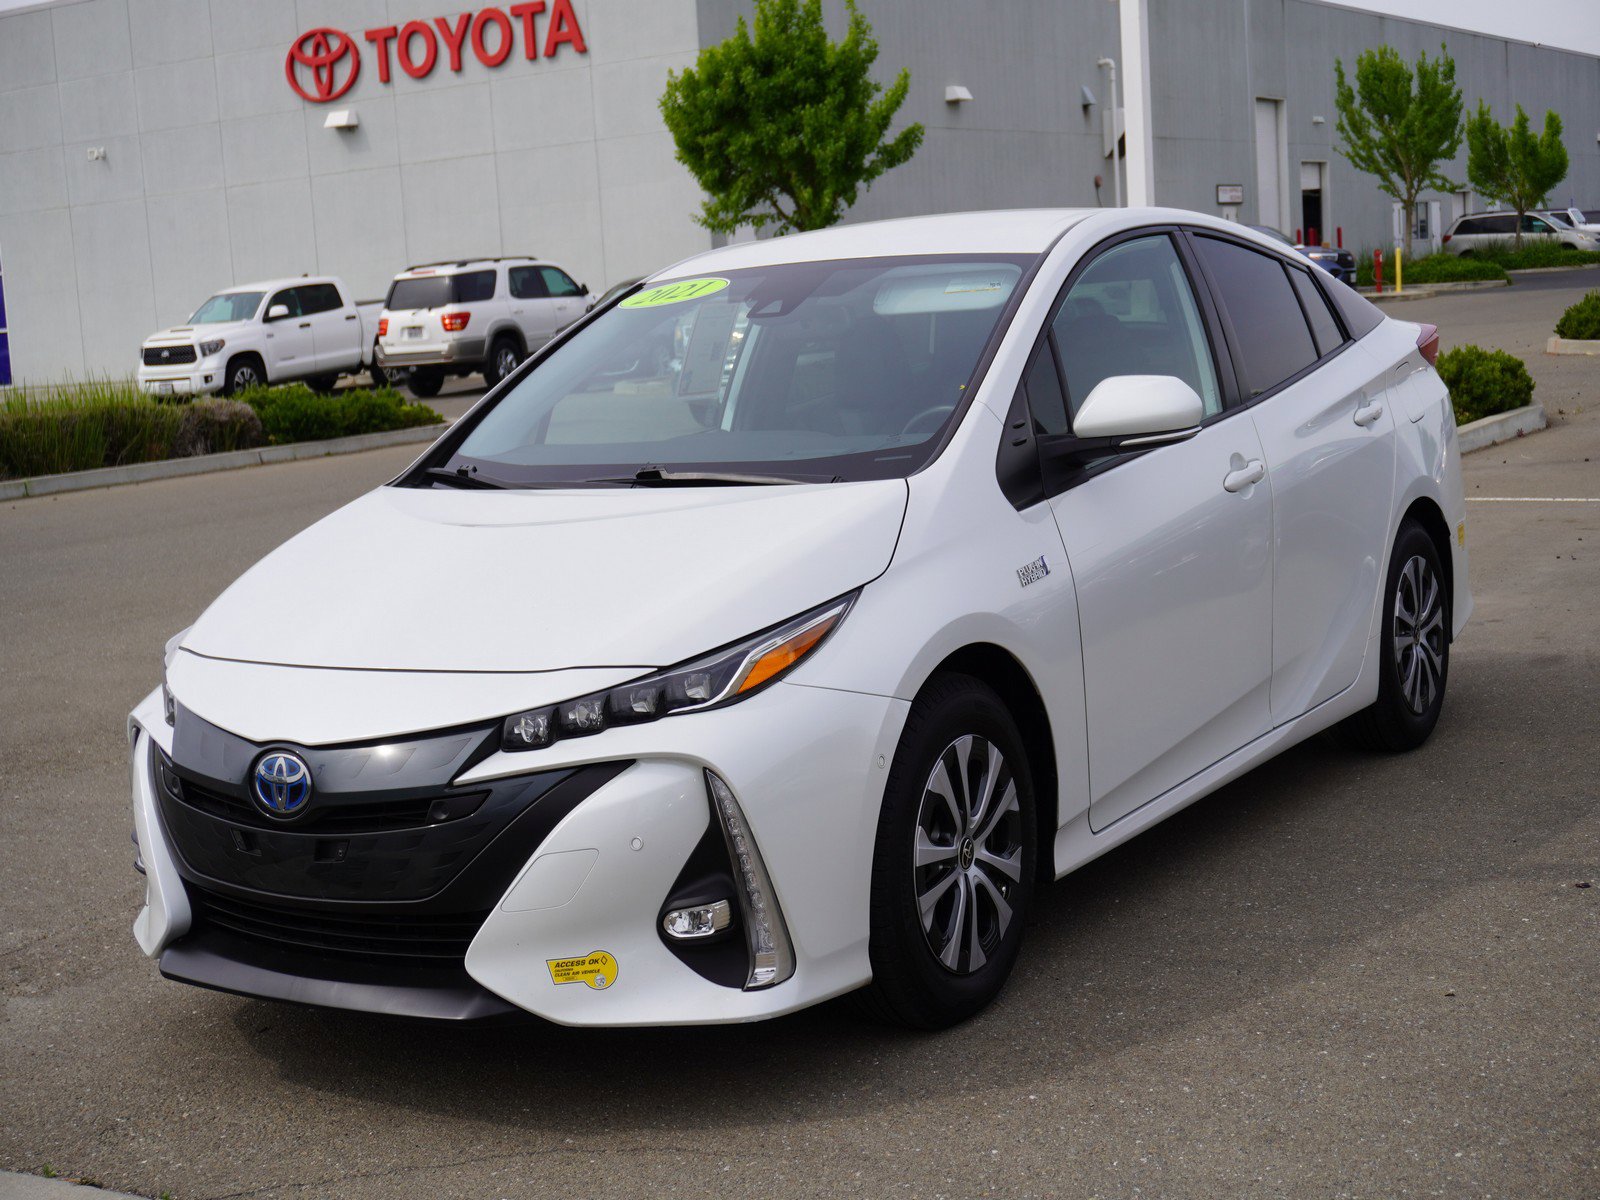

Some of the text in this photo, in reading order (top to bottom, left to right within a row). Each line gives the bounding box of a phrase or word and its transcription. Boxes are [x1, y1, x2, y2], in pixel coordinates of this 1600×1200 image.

[364, 0, 588, 84] TOYOTA
[631, 280, 717, 306] 2021
[1020, 569, 1047, 587] HYBRID
[555, 959, 586, 968] ACCESS
